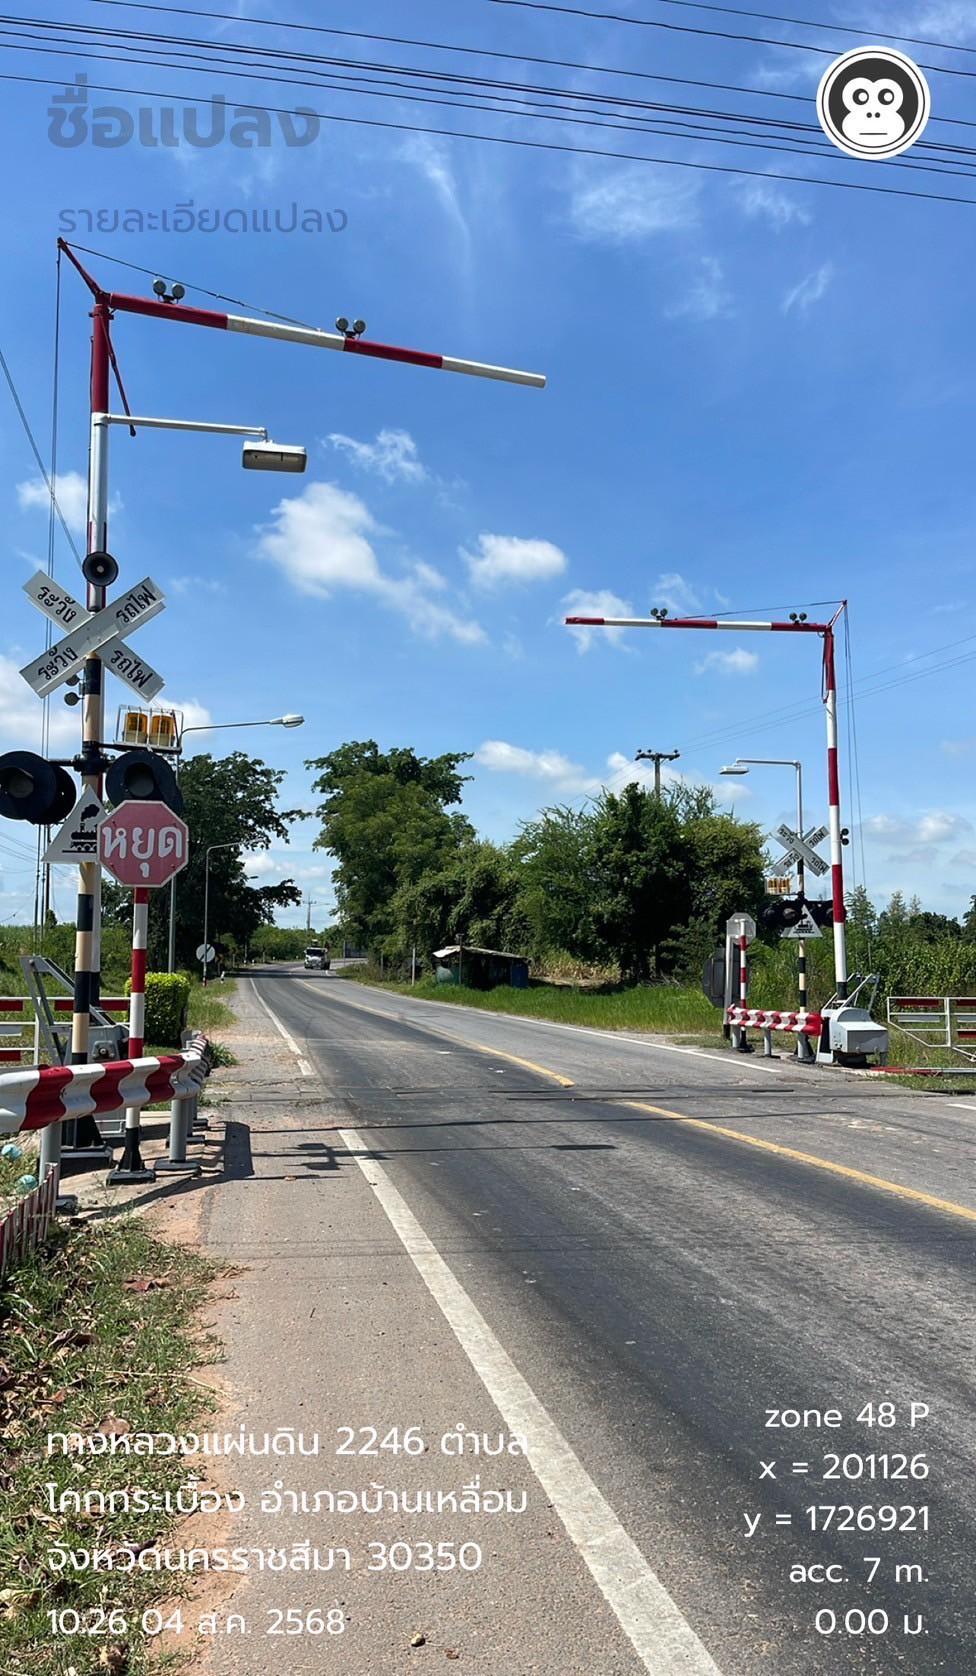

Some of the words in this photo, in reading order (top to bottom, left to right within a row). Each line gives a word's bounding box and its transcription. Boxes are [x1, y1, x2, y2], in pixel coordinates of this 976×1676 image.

[37, 586, 77, 623] ระวัง
[110, 650, 153, 688] รถไฟ
[38, 646, 78, 680] ระวัง
[116, 585, 157, 623] รถไฟ
[102, 826, 183, 878] หยุด
